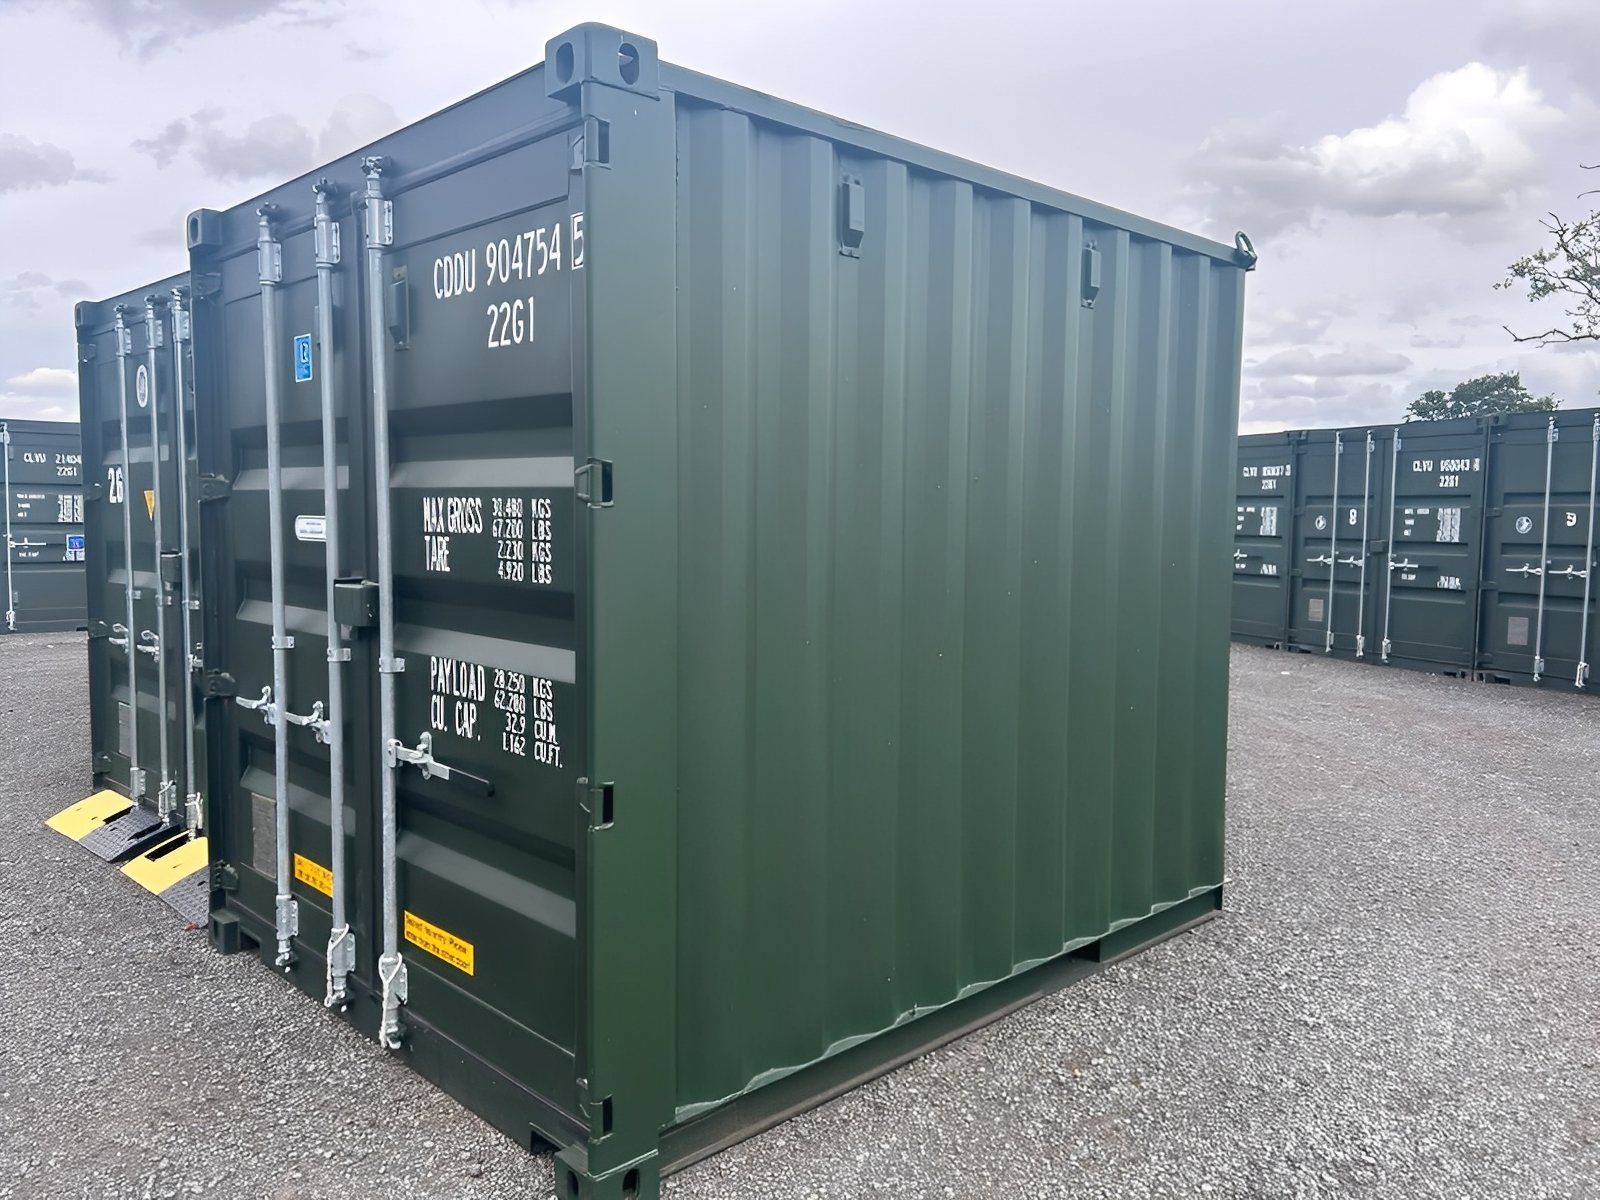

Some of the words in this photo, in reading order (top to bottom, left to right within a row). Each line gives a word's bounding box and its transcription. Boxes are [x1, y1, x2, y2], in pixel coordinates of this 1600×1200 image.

[433, 248, 476, 299] CDDU
[486, 223, 561, 287] 904754
[572, 214, 584, 268] 5
[487, 296, 534, 349] 22G1
[107, 467, 123, 504] 26
[423, 497, 445, 533] MAX
[447, 497, 483, 534] GROSS
[531, 498, 552, 519] KGS
[1349, 508, 1358, 526] 8
[531, 519, 552, 541] LBS
[424, 535, 451, 572] TARE
[531, 541, 552, 563] KGS
[531, 562, 552, 584] LBS
[430, 655, 486, 702] PAYLOAD
[532, 676, 553, 700] KGS
[533, 697, 554, 722] LBS
